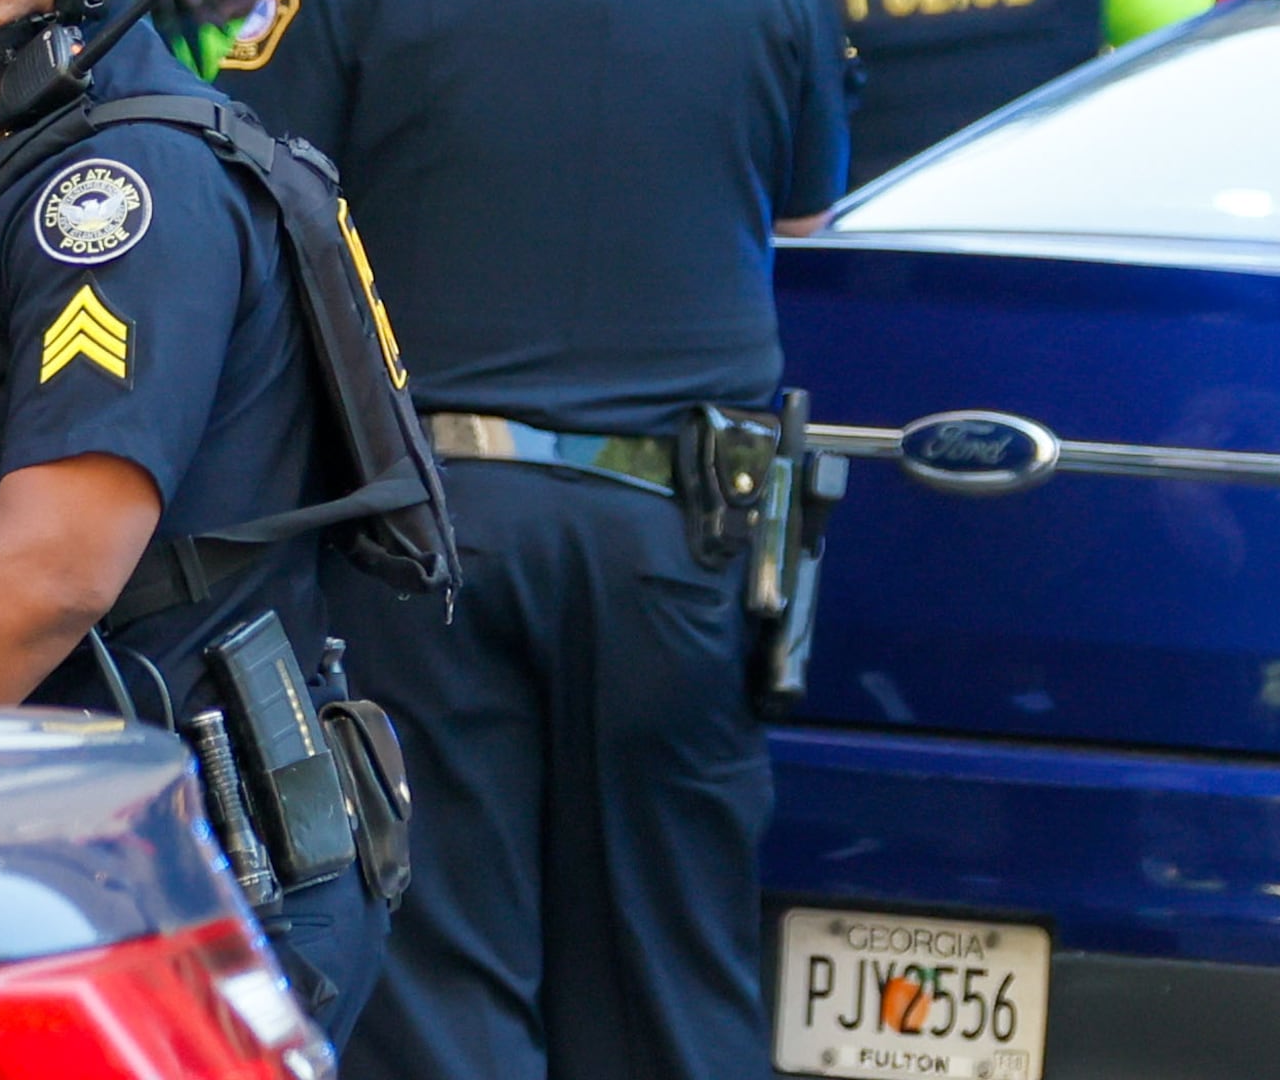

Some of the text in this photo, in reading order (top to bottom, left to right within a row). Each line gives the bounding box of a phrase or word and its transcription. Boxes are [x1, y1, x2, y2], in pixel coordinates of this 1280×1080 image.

[45, 168, 141, 228] CITY OF ATLANTA
[60, 226, 130, 254] POLICE
[926, 421, 1013, 464] Ford
[846, 923, 986, 960] GEORGIA
[804, 953, 1018, 1044] PJY2556
[859, 1047, 950, 1073] FULTON
